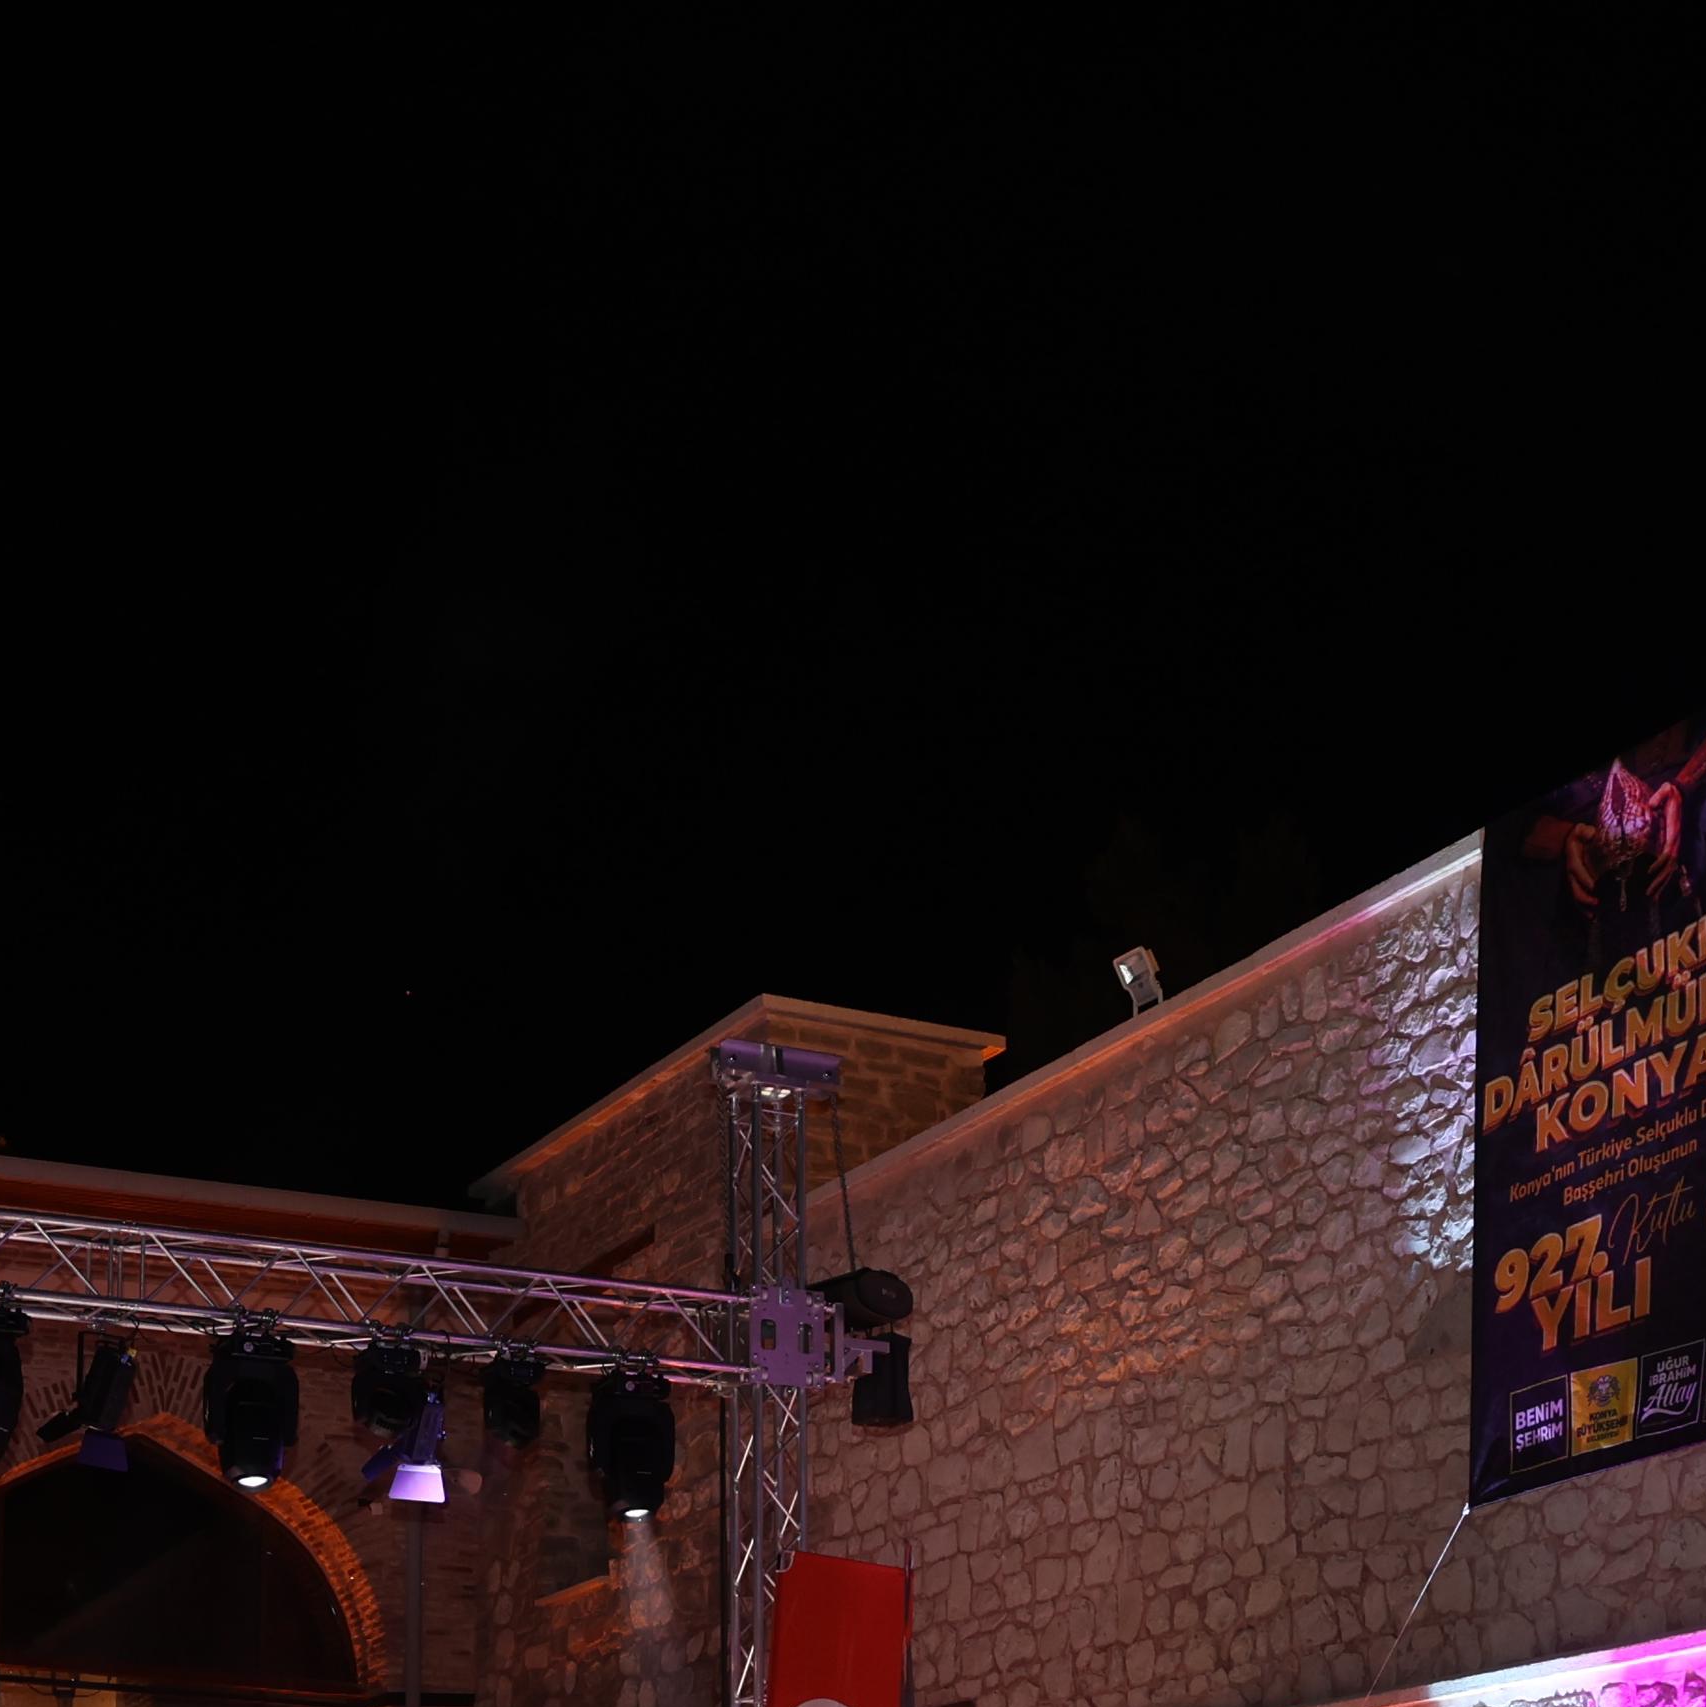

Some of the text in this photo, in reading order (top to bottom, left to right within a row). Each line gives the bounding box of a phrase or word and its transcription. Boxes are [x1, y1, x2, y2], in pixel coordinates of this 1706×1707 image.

[1509, 1159, 1575, 1203] Konya'nın
[1578, 1135, 1632, 1170] Türkiye
[1636, 1105, 1697, 1146] Selçuklu
[1563, 1136, 1698, 1207] Başşehri Oluşunun
[1494, 1213, 1609, 1314] 927.
[1608, 1175, 1697, 1266] Kutlu
[1531, 1255, 1652, 1352] YILI
[1656, 1355, 1690, 1372] UĞUR
[1515, 1398, 1563, 1431] BENİM
